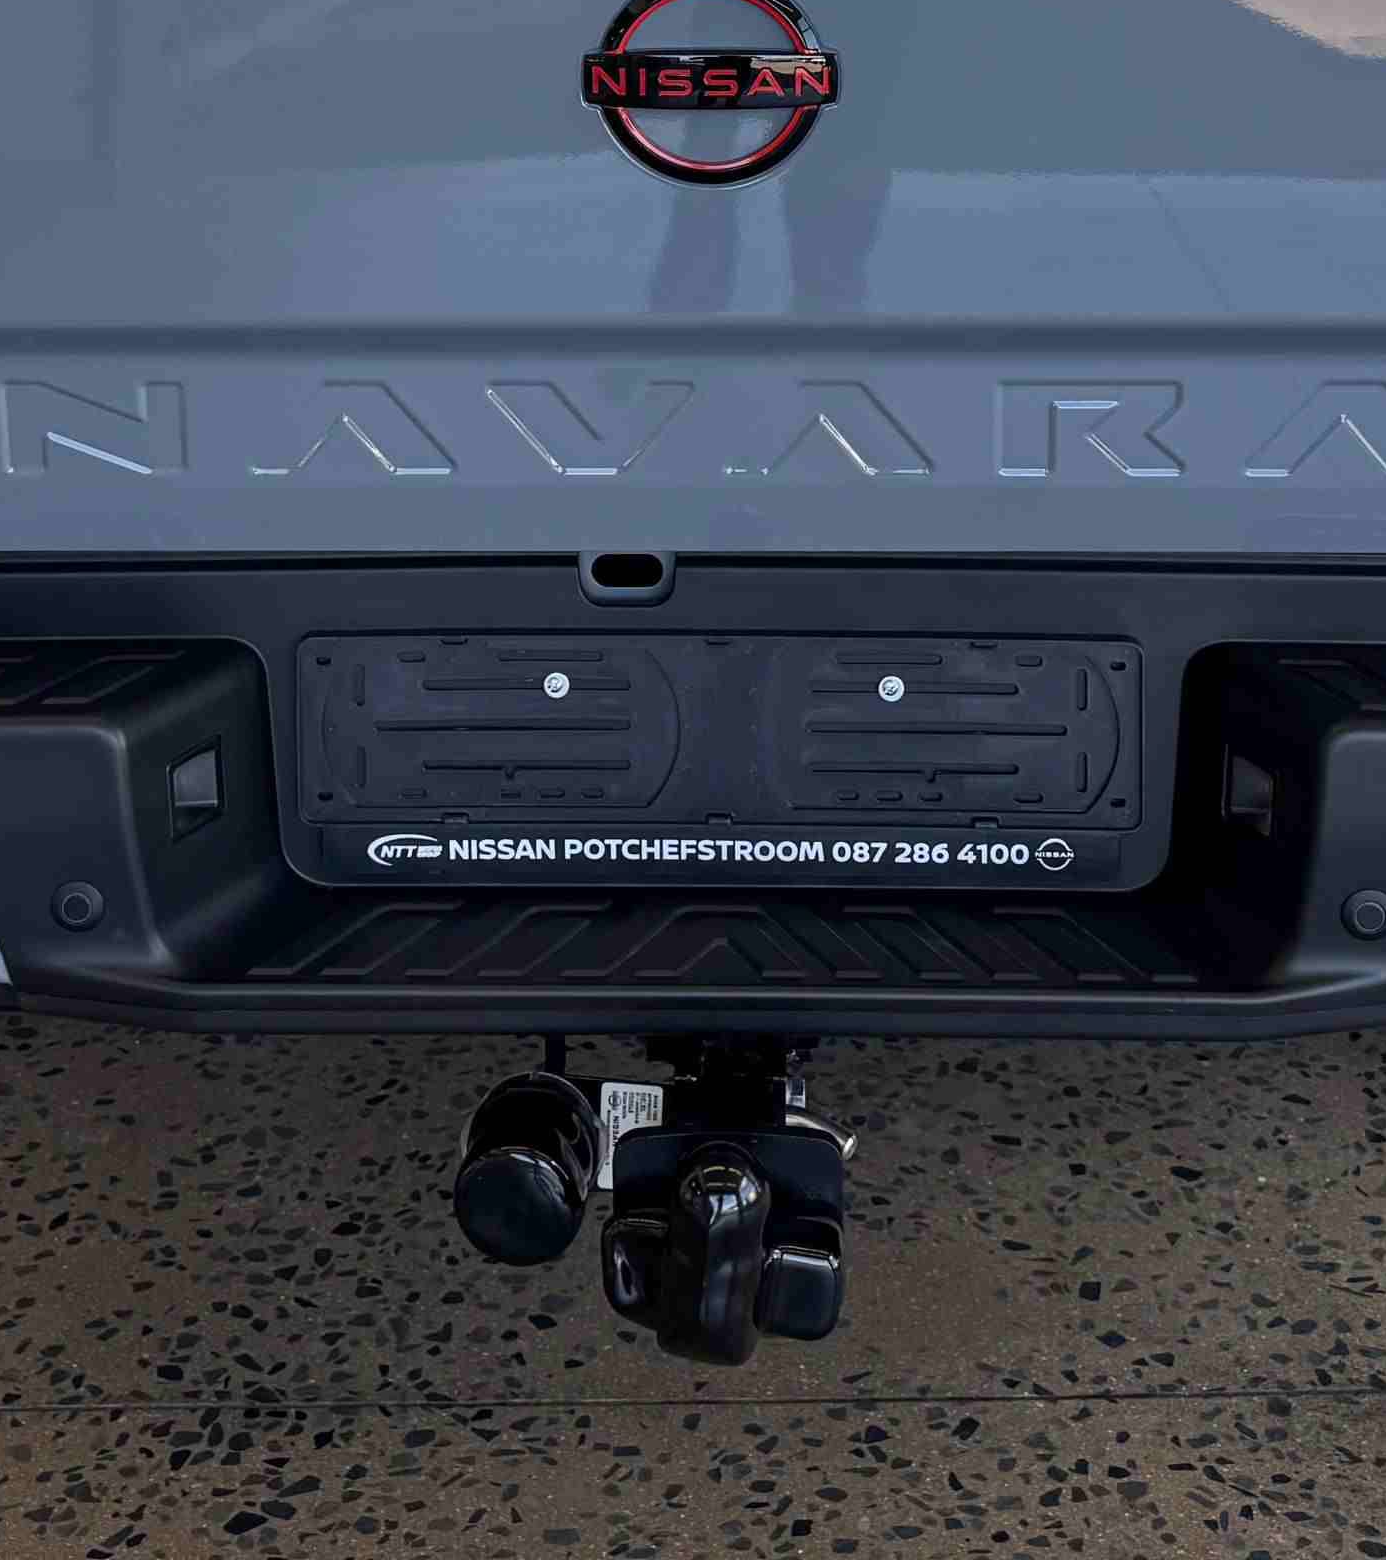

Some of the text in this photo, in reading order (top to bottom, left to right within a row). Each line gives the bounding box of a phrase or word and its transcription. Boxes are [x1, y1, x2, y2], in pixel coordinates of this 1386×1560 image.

[589, 65, 832, 97] NISSAN
[449, 839, 556, 860] NISSAN
[564, 839, 825, 862] POTCHEFSTROOM
[832, 842, 888, 863] 087
[894, 843, 950, 863] 286
[956, 843, 1030, 865] 4100
